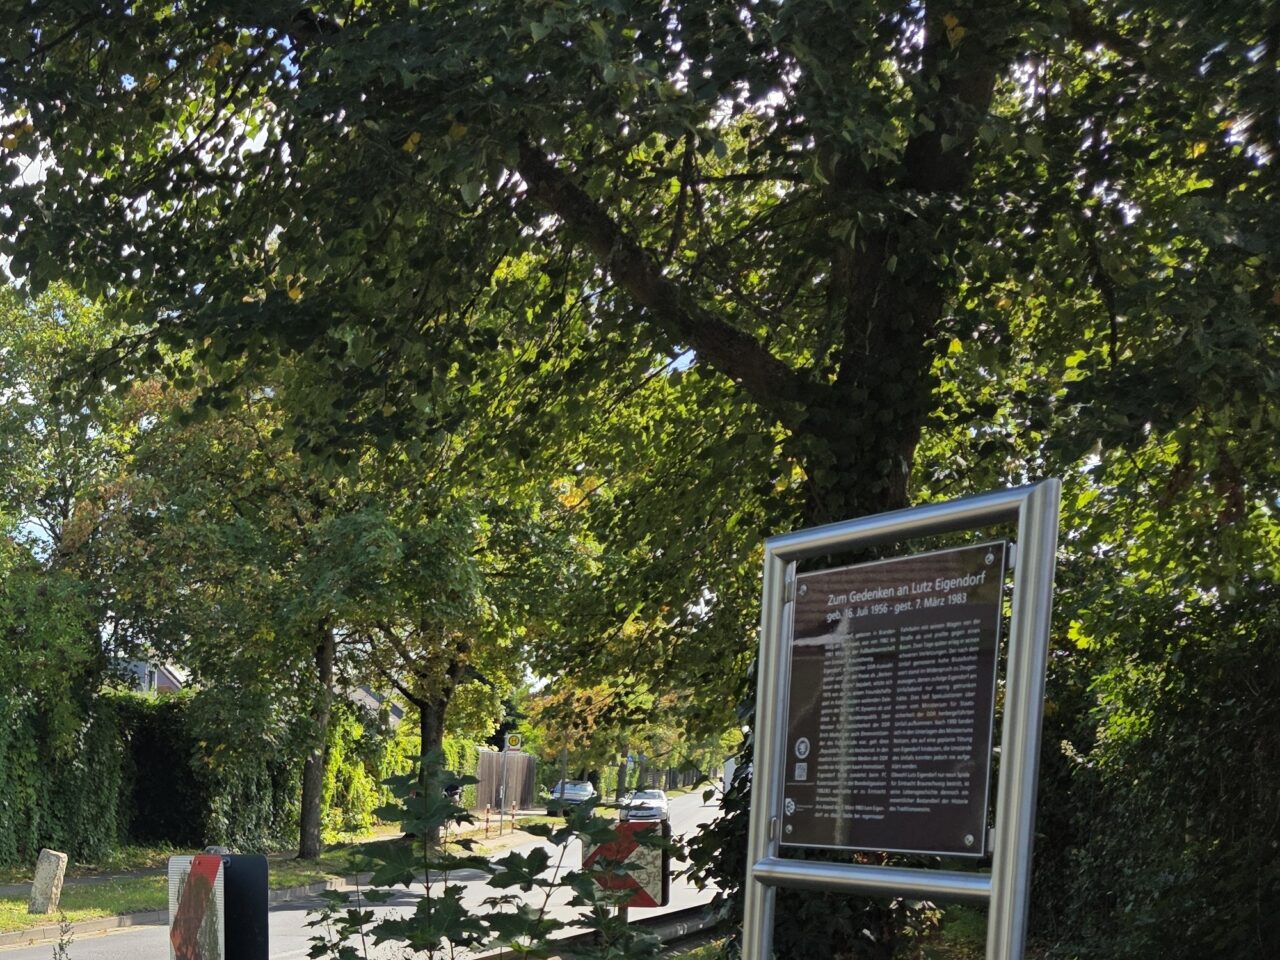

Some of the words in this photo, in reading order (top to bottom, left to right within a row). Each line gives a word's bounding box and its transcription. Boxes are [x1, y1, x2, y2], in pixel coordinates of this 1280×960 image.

[827, 594, 847, 606] Zum
[849, 586, 895, 603] Gedenken
[897, 585, 909, 596] an
[911, 581, 933, 594] Lutz
[935, 570, 987, 592] Eigendorf
[826, 611, 842, 623] geb.
[856, 606, 869, 616] Juli
[871, 602, 888, 614] 1956
[894, 602, 914, 615] gest.
[916, 599, 922, 608] 7.
[924, 596, 945, 608] März
[948, 593, 968, 604] 1983
